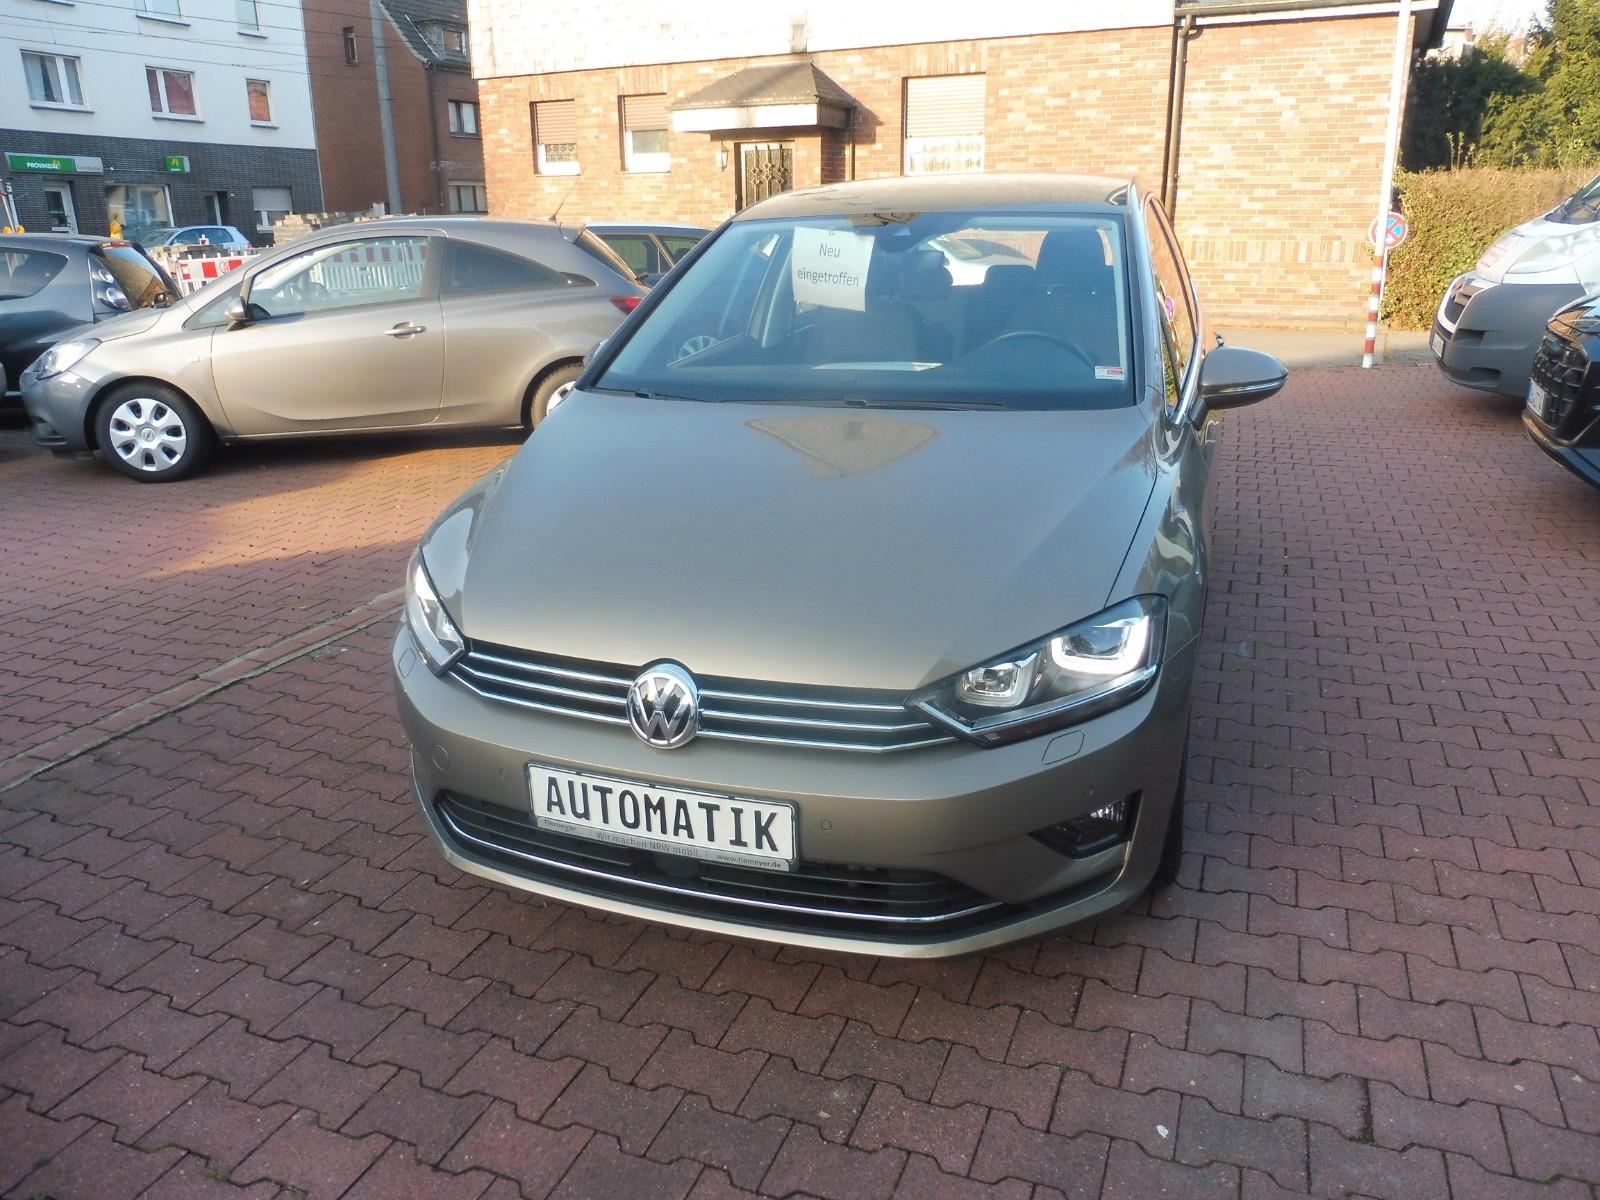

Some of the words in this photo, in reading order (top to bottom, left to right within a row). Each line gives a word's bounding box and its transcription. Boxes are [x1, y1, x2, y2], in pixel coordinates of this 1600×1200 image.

[819, 243, 841, 258] Neu
[797, 267, 860, 287] eingetroffen
[546, 776, 779, 852] AUTOMATIK
[543, 819, 577, 832] Tiemeyer
[596, 831, 611, 842] Wir
[612, 835, 648, 849] machen
[649, 841, 671, 852] NRW
[716, 854, 782, 868] www.tiemeyer.de
